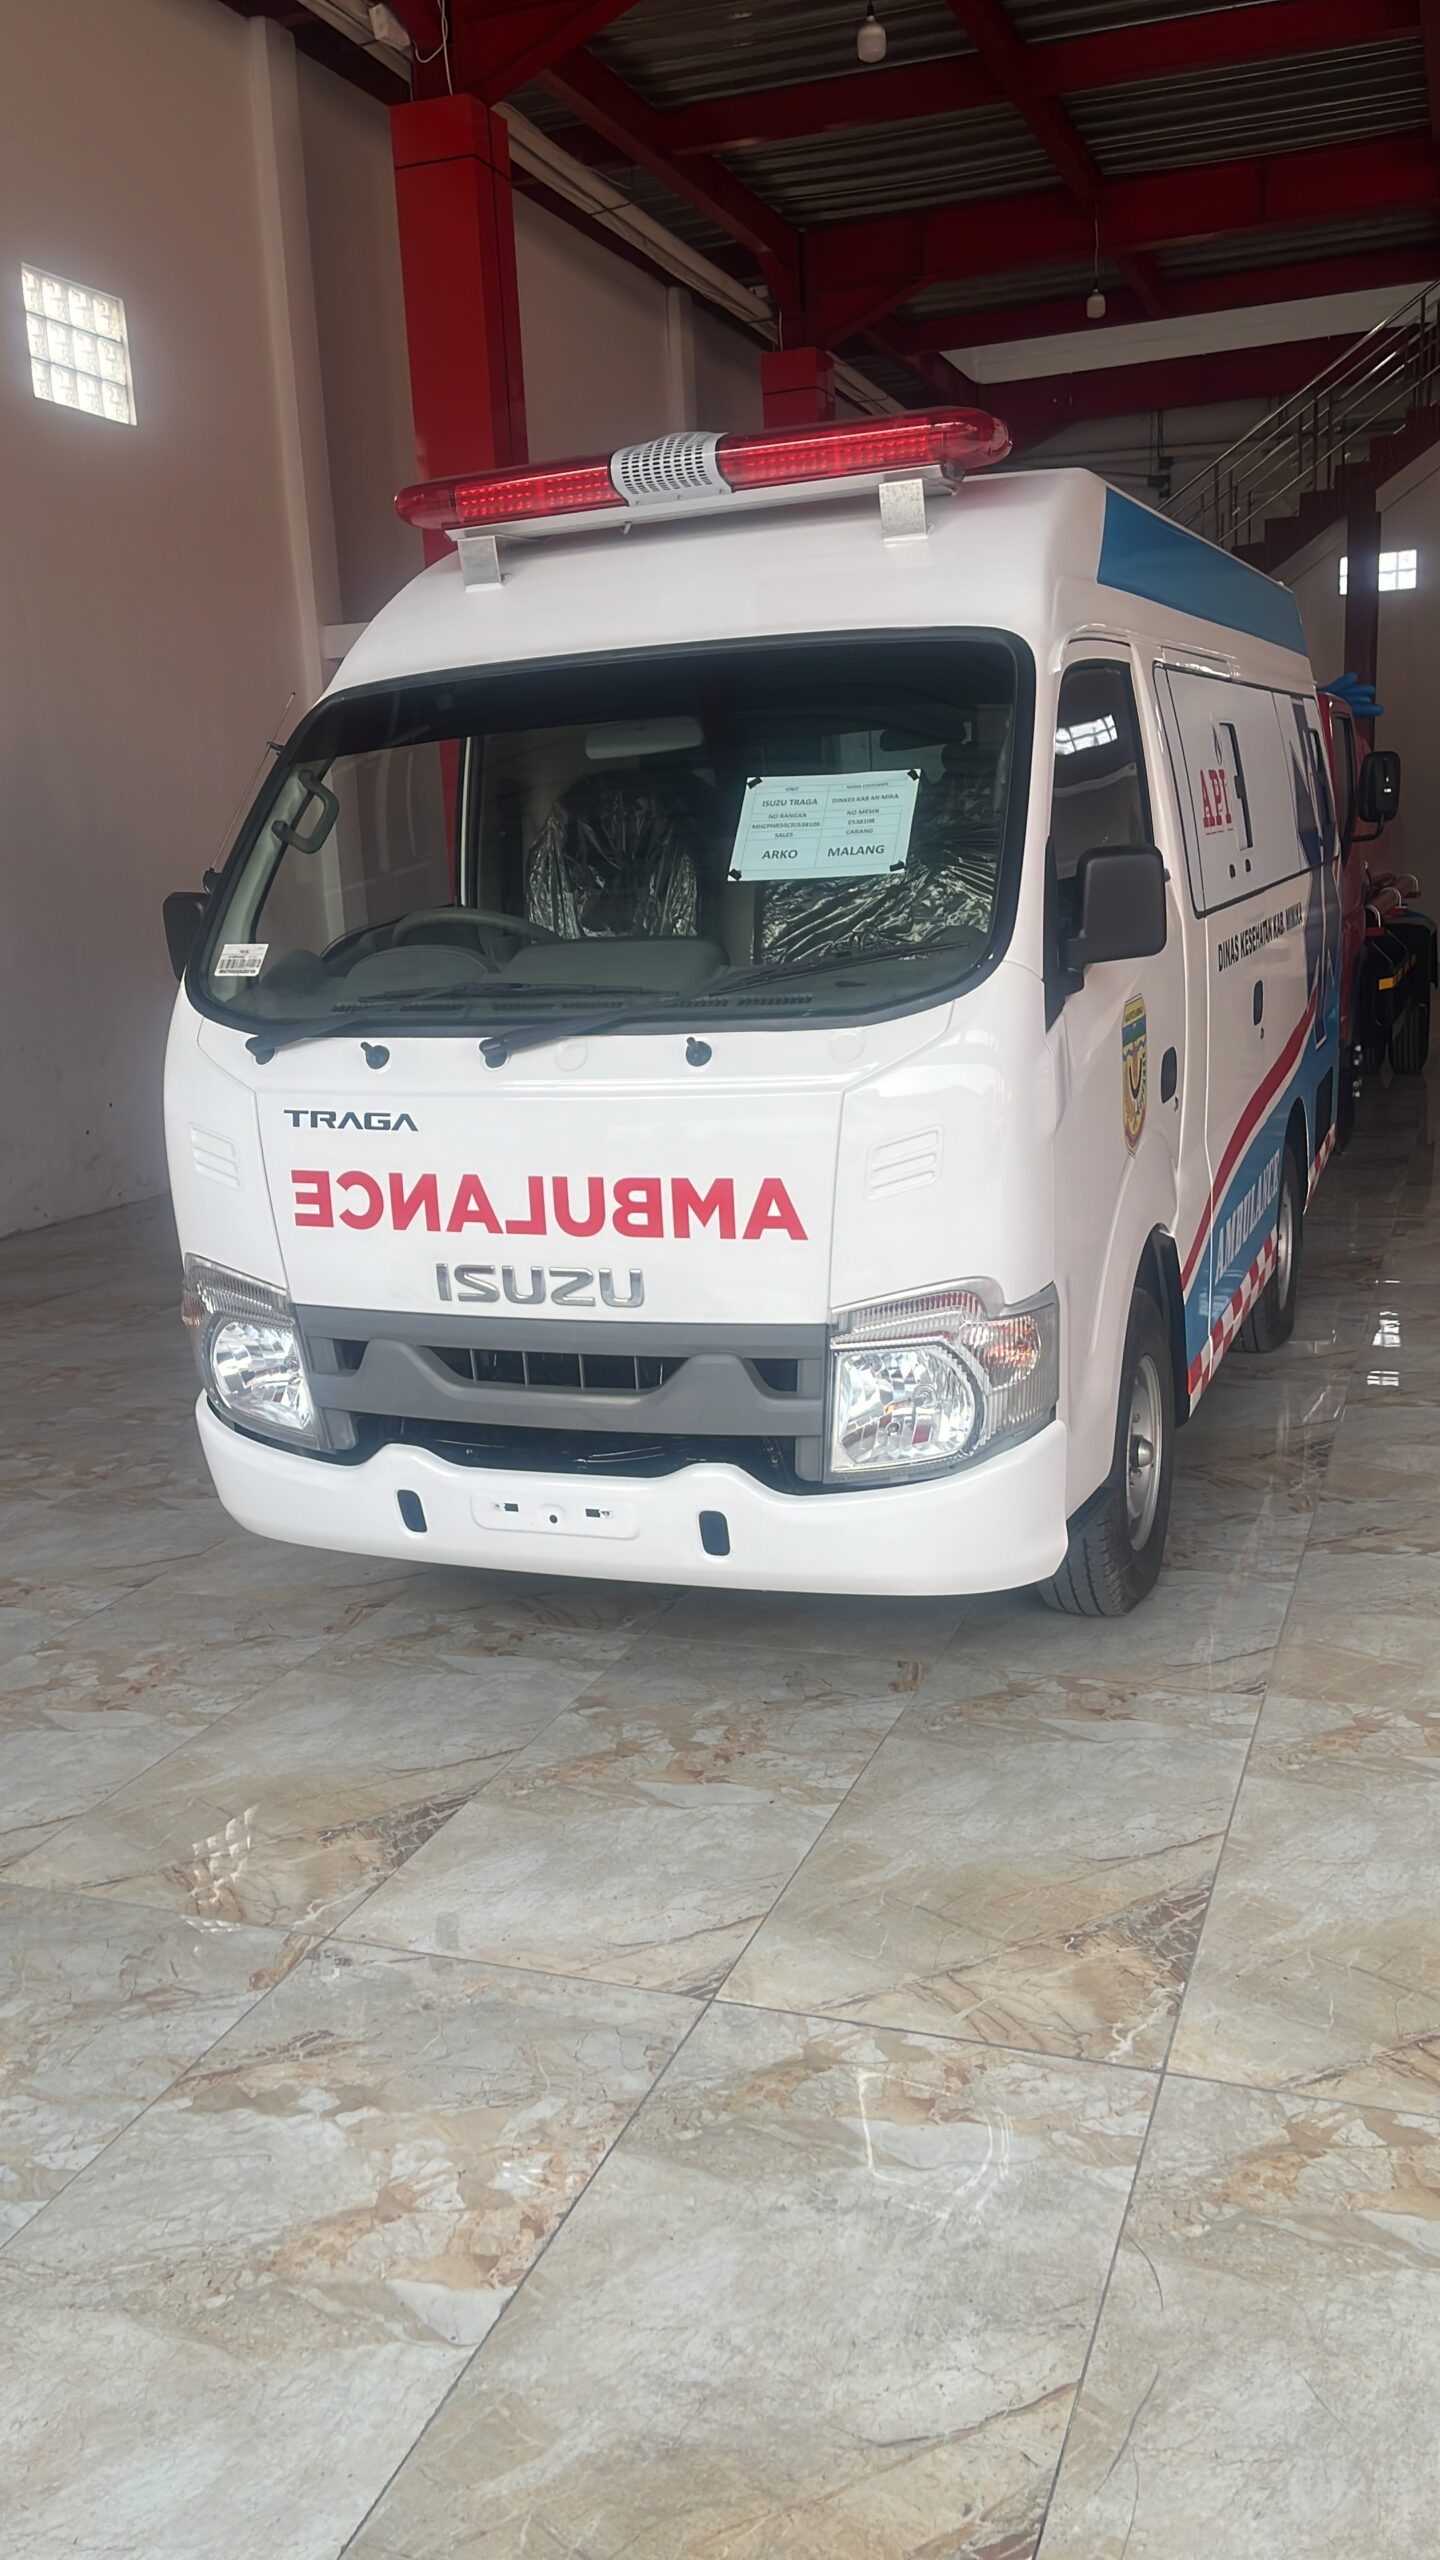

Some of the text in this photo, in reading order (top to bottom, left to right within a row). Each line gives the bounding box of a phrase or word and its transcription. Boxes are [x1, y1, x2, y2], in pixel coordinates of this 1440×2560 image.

[761, 849, 798, 859] ARKO
[827, 845, 885, 857] MALANG
[1218, 934, 1239, 972] DINAS
[1240, 916, 1272, 959] KESEHATAN
[283, 1109, 419, 1131] TRAGA
[1214, 1148, 1280, 1286] AMBULANCE
[435, 1263, 645, 1308] ISUZU
